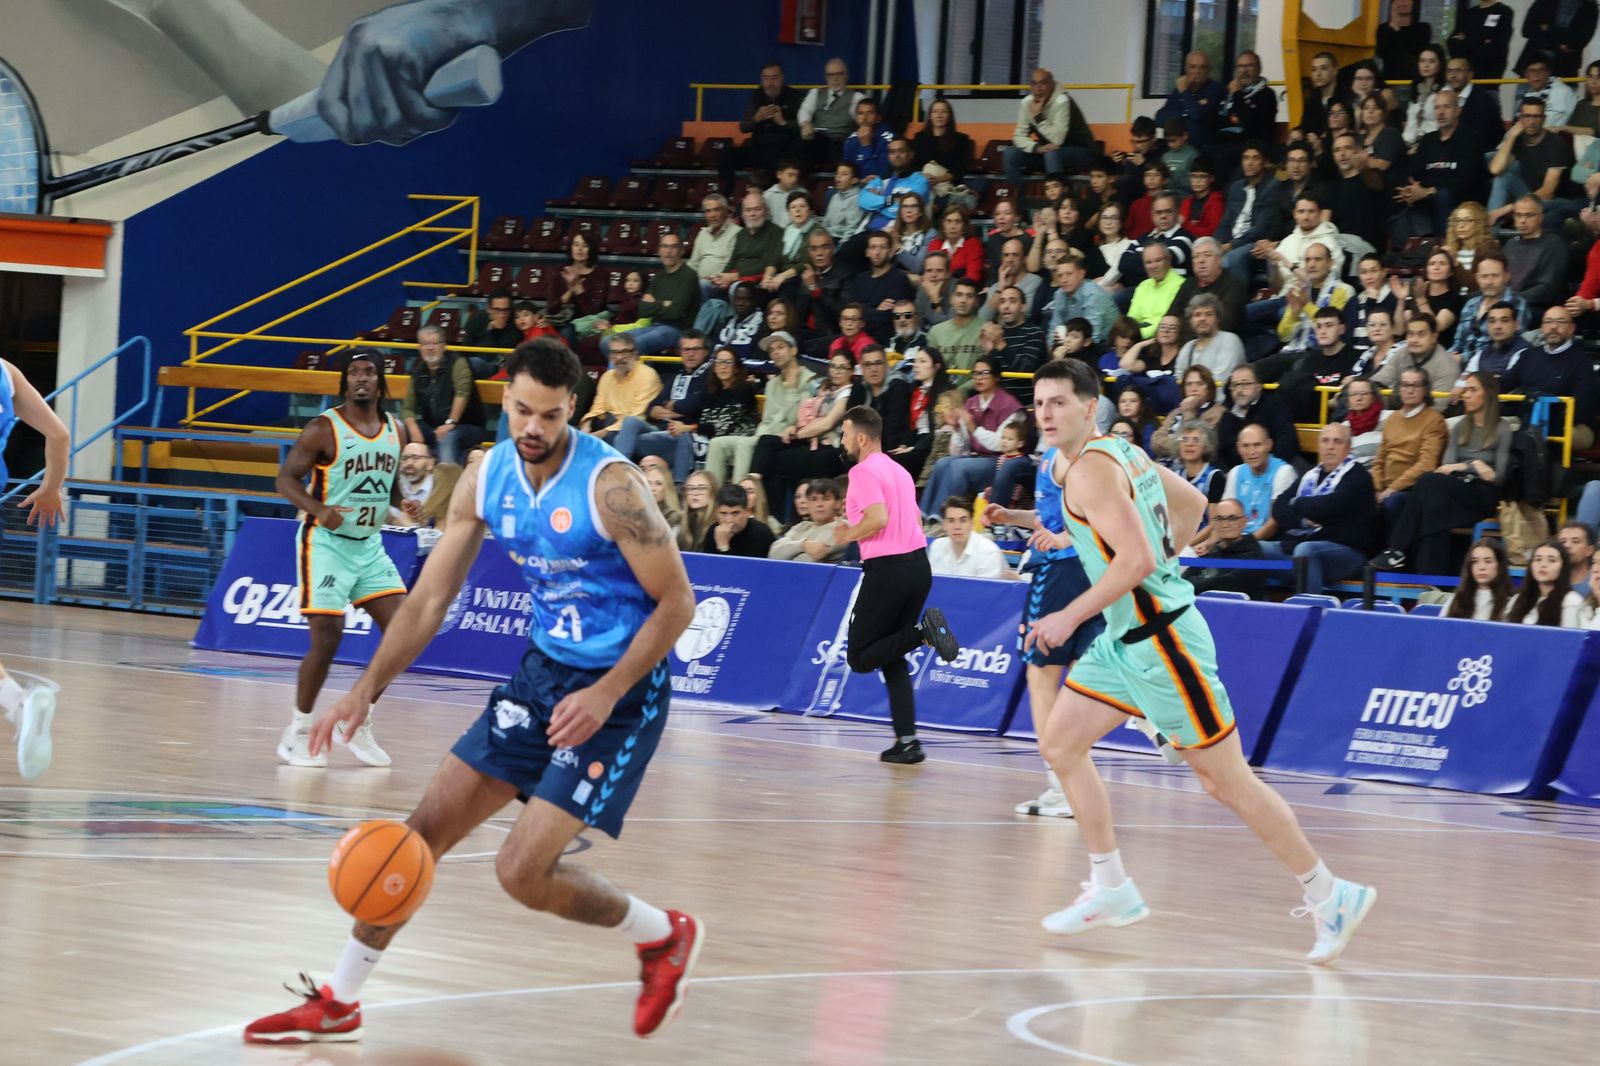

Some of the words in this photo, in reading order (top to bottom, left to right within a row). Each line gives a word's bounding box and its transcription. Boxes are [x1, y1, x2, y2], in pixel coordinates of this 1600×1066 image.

[357, 506, 377, 526] 21
[547, 604, 583, 642] 21
[1360, 687, 1460, 730] FITECU
